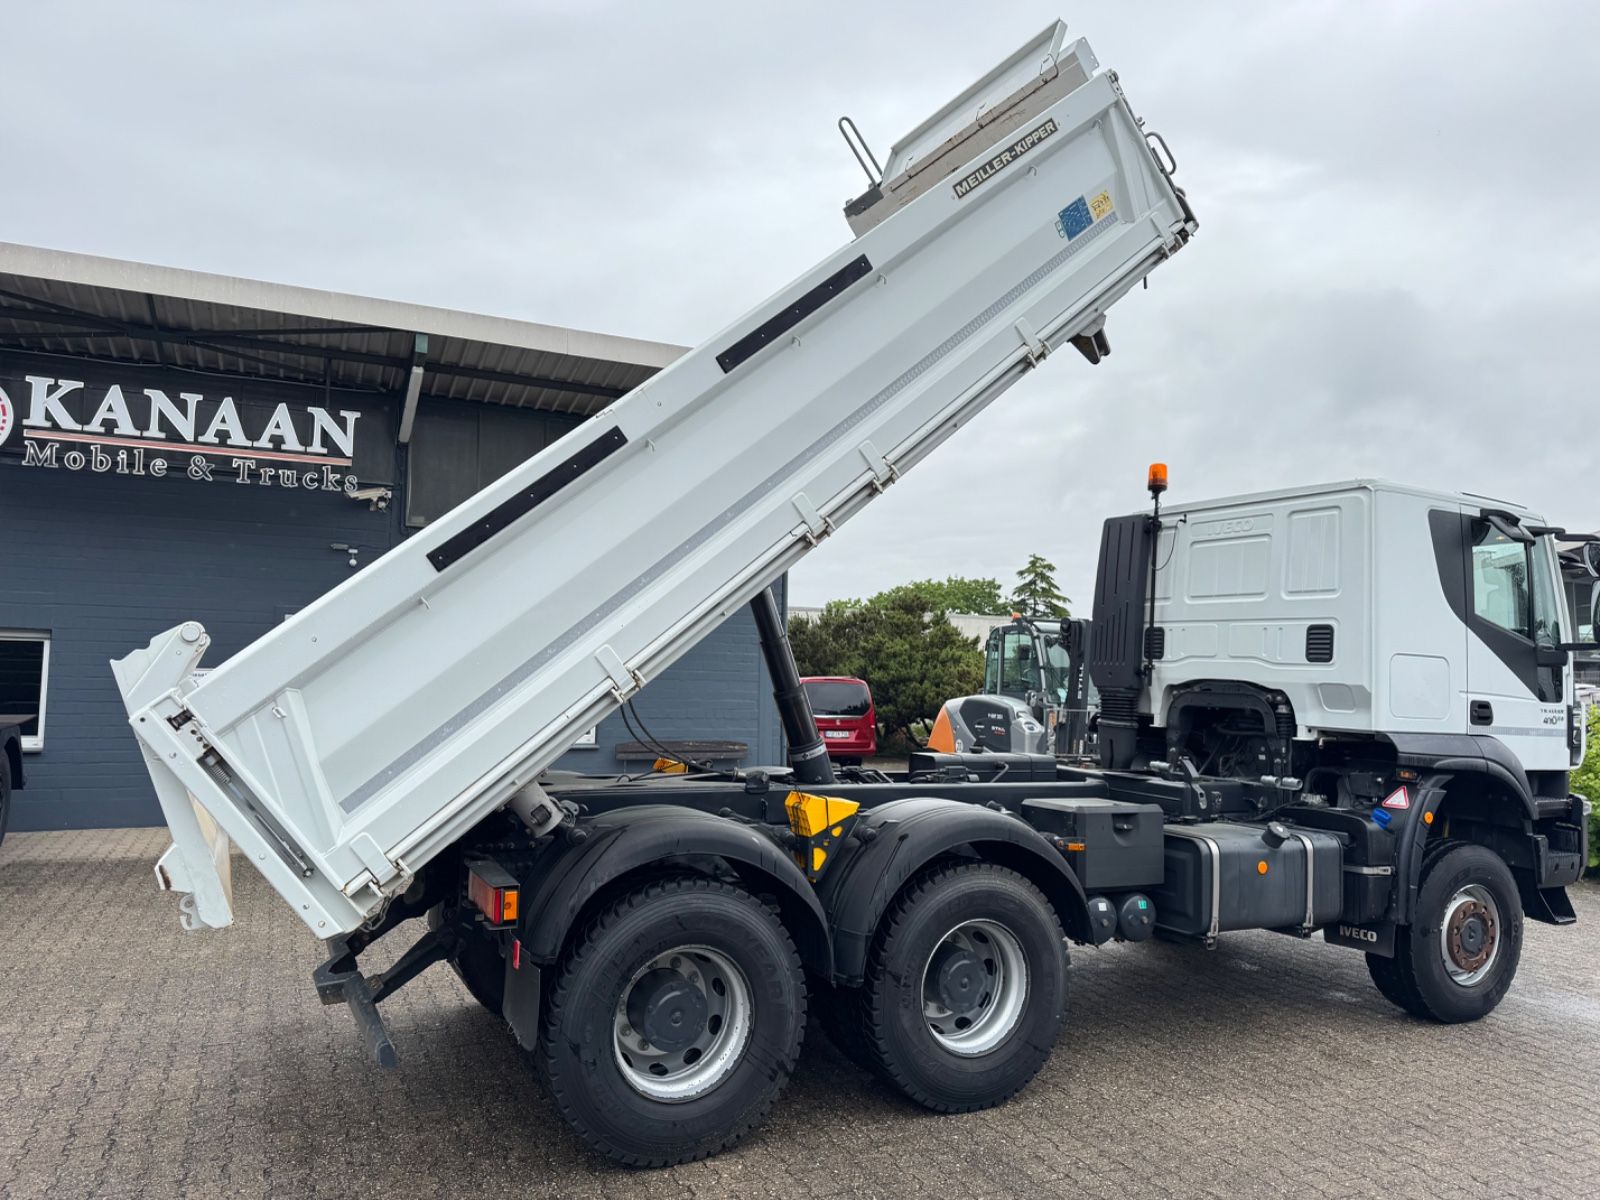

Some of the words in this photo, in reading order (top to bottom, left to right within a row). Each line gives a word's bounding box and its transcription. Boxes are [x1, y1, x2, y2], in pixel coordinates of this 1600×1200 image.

[955, 120, 1057, 197] MEILLER-KIPPER
[22, 375, 361, 457] KANAAN
[22, 439, 168, 477] Mobile
[188, 455, 216, 482] &
[233, 457, 358, 492] Trucks
[1208, 519, 1254, 536] IVECO
[1339, 925, 1377, 942] IVECO
